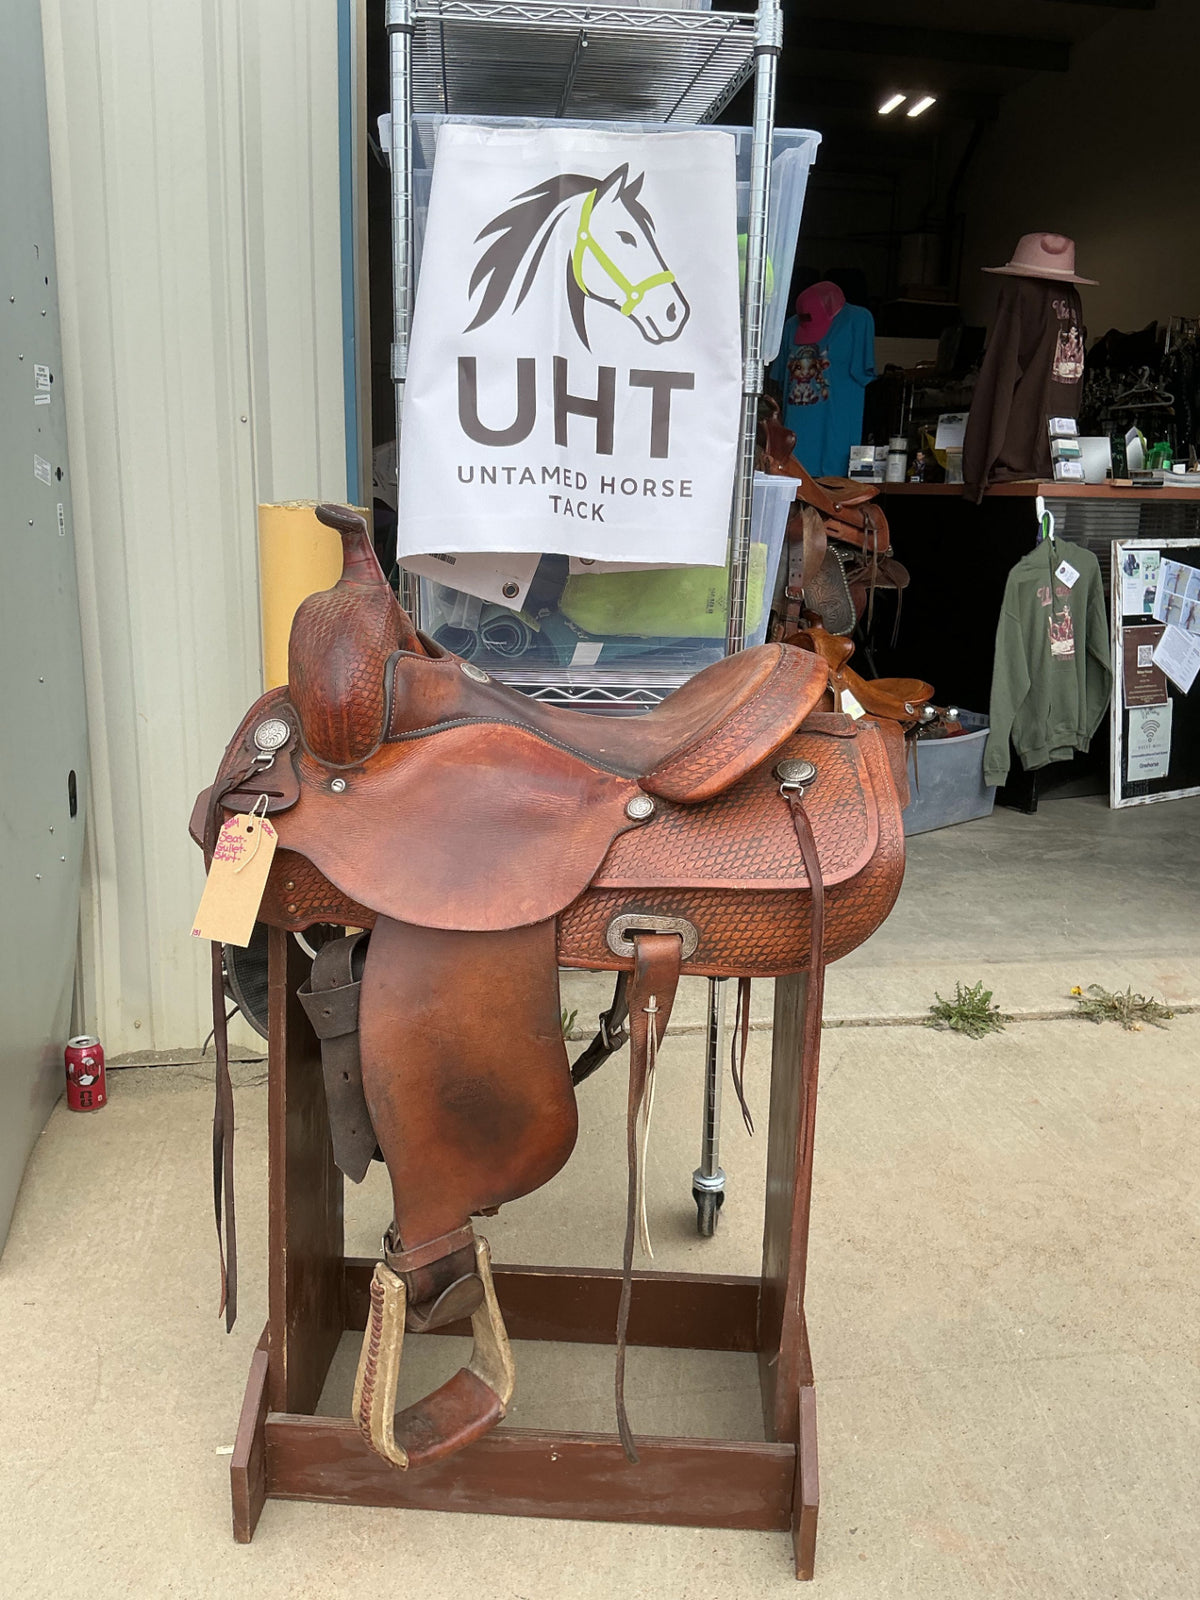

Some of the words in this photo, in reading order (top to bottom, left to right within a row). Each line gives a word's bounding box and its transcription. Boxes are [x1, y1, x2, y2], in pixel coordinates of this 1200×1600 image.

[458, 356, 695, 459] UHT
[458, 466, 587, 490] UNTAMED
[600, 476, 693, 498] HORSE
[549, 495, 605, 522] TACK
